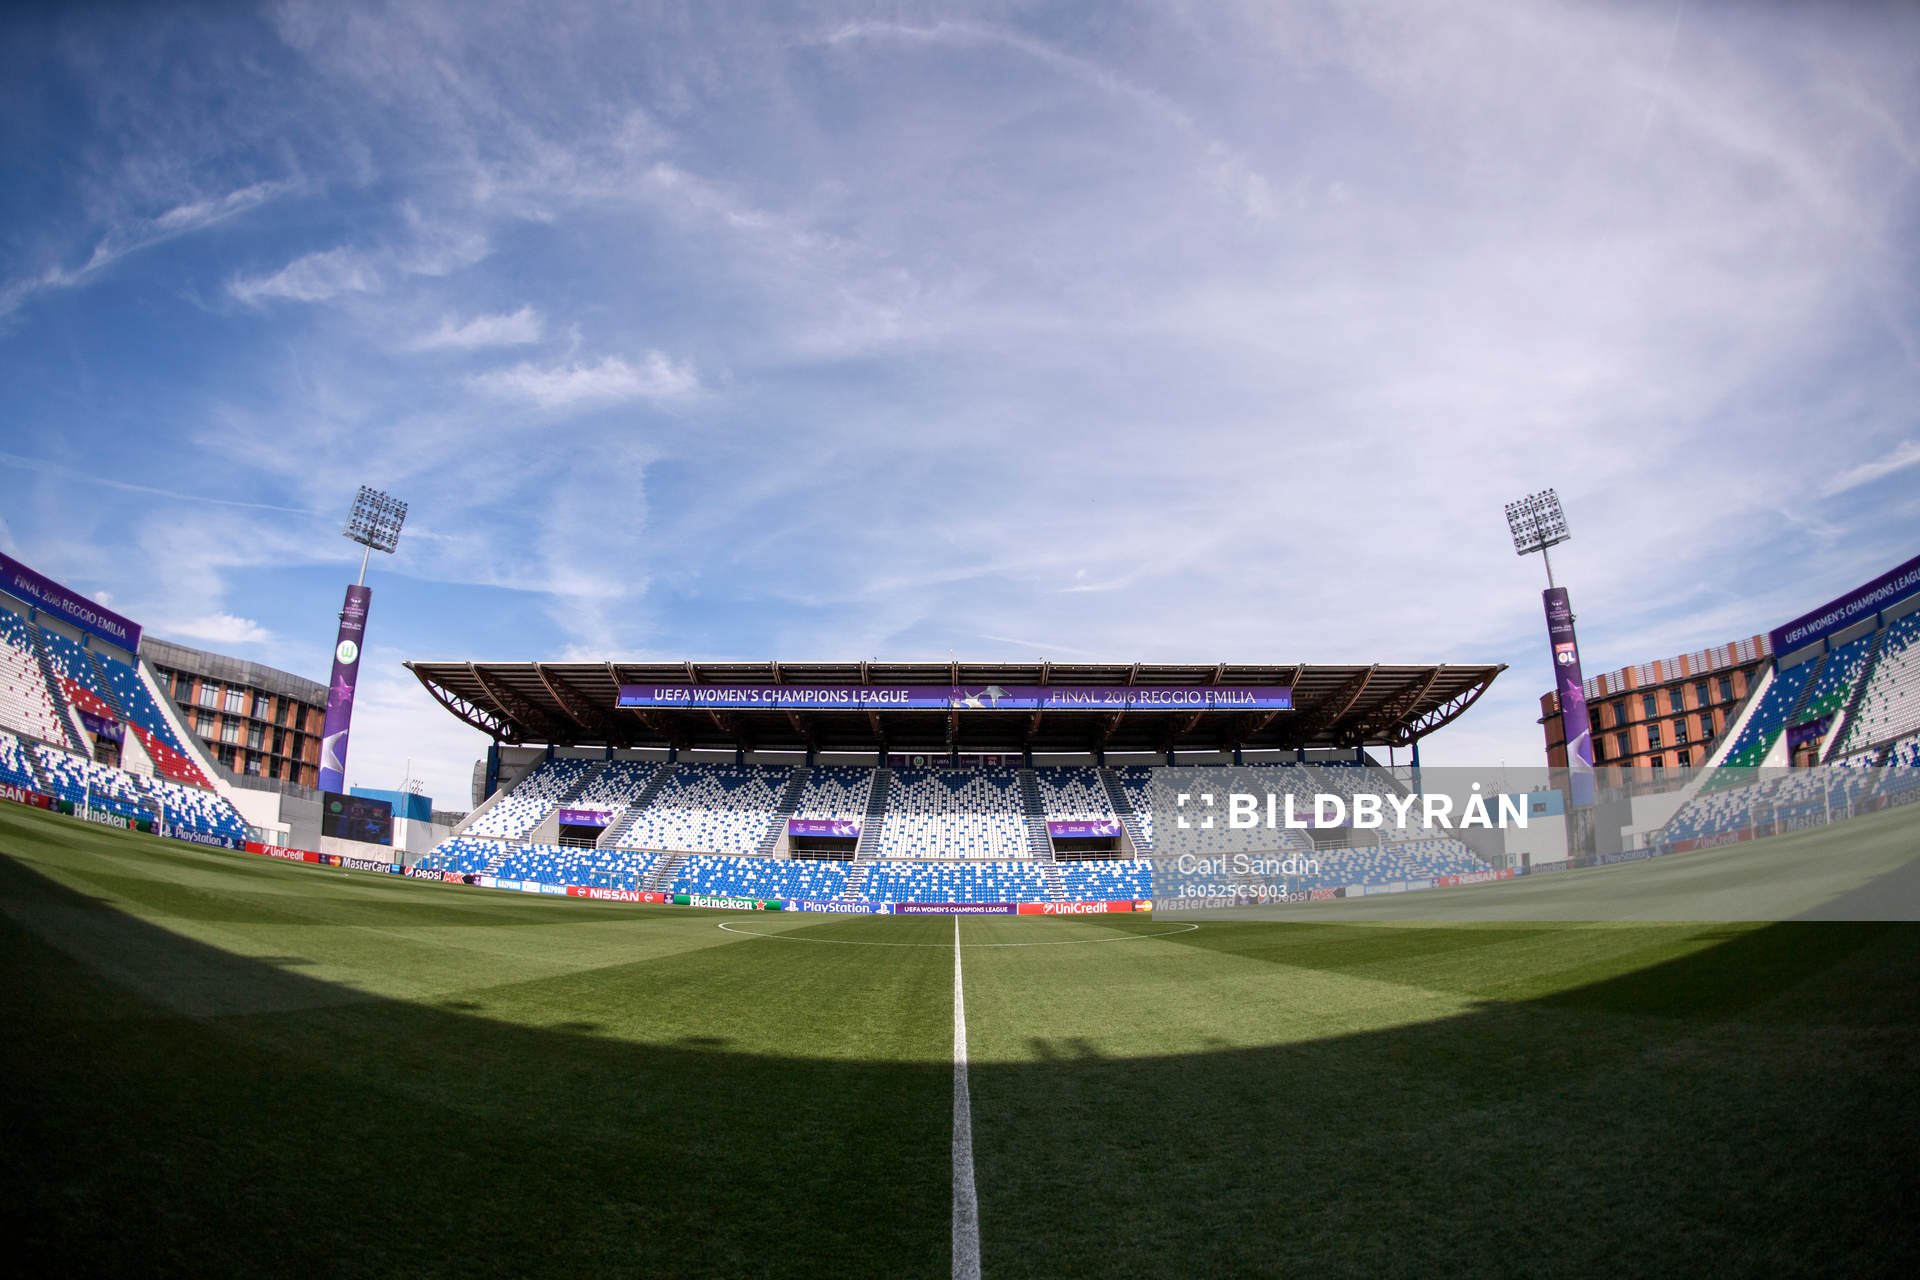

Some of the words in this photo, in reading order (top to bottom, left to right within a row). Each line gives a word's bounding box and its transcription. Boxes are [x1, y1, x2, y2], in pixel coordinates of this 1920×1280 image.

[14, 575, 41, 597] FINAL
[62, 599, 97, 624] REGGIO
[98, 616, 126, 639] EMILIA
[1785, 627, 1808, 644] UEFA
[1807, 609, 1846, 633] WOMEN'S
[1845, 582, 1894, 615] CHAMPIONS
[1558, 651, 1575, 663] OL
[654, 689, 691, 701] UEFA
[693, 689, 759, 702] WOMEN'S
[762, 690, 848, 703] CHAMPIONS
[852, 690, 909, 703] LEAGUE
[1052, 690, 1100, 704] FINAL
[1104, 691, 1137, 704] 2016
[1140, 691, 1201, 704] REGGIO
[1205, 691, 1256, 704] EMILIA
[175, 825, 222, 846] PlayStation
[1701, 833, 1739, 849] UniCredit
[270, 846, 305, 861] UniCredit
[1605, 850, 1650, 864] PlayStation
[342, 857, 391, 873] MasterCard
[1531, 862, 1568, 876] Heineken
[415, 868, 442, 880] pepsi
[442, 871, 466, 885] MAX
[1458, 872, 1497, 885] NISSAN
[590, 888, 640, 902] NISSAN
[1310, 887, 1338, 901] MAX
[689, 895, 753, 910] Heineken
[1055, 902, 1108, 914] UniCredit
[1155, 896, 1235, 912] MasterCard
